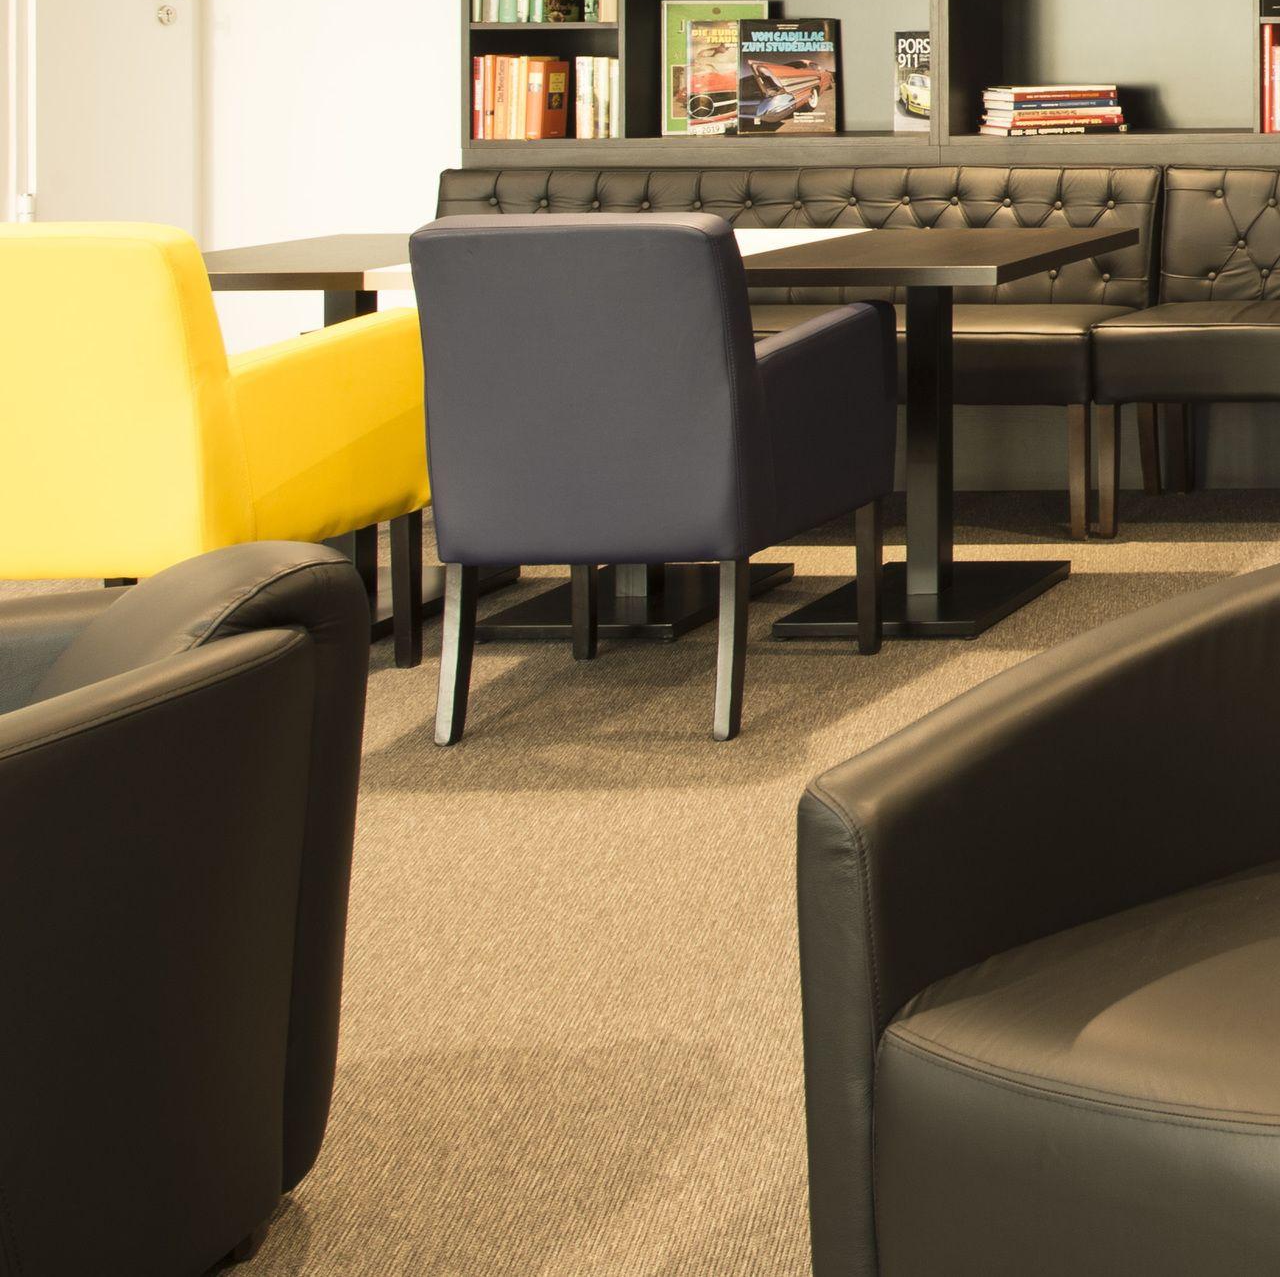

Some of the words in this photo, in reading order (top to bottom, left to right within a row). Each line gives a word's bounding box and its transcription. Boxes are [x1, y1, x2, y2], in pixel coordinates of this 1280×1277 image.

[751, 31, 776, 42] VOM
[775, 31, 825, 42] CADILLAC
[742, 41, 767, 52] ZUM
[767, 41, 834, 52] STUDEBAKER
[898, 38, 930, 53] PORS
[898, 53, 918, 67] 911
